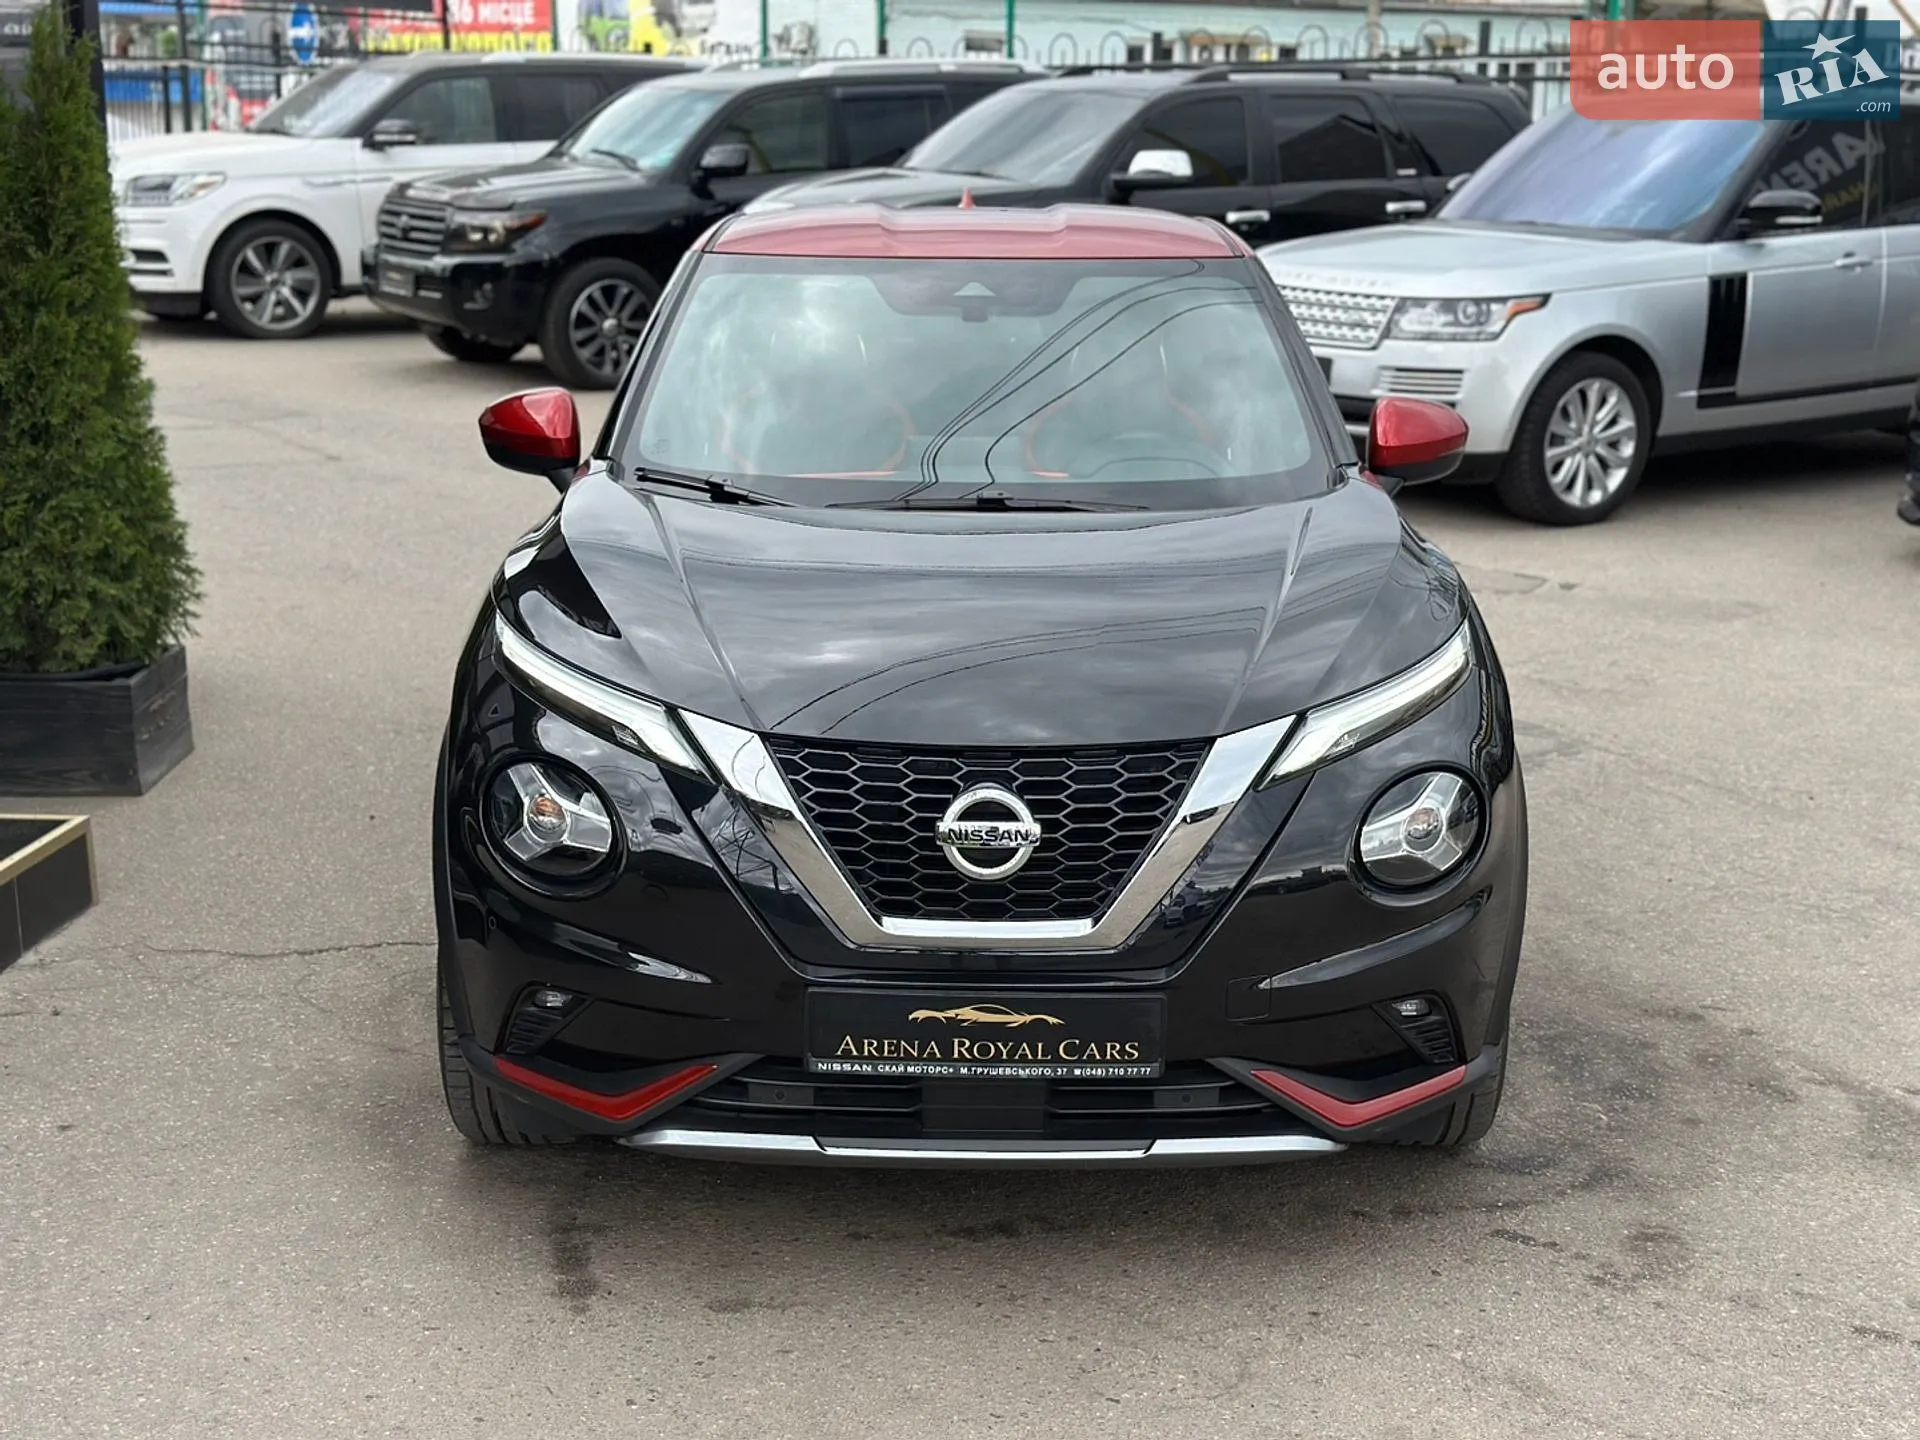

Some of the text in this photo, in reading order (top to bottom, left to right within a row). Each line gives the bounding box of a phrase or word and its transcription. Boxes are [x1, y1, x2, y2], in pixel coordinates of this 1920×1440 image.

[947, 828, 1029, 843] NISSAN
[834, 1034, 1139, 1061] ARENA ROYAL CARS
[818, 1062, 872, 1072] NISSAN
[877, 1063, 905, 1073] СКАЙ
[1056, 1067, 1068, 1076] 37
[1108, 1067, 1124, 1076] 710
[1126, 1067, 1139, 1076] 77
[1140, 1067, 1152, 1076] 77
